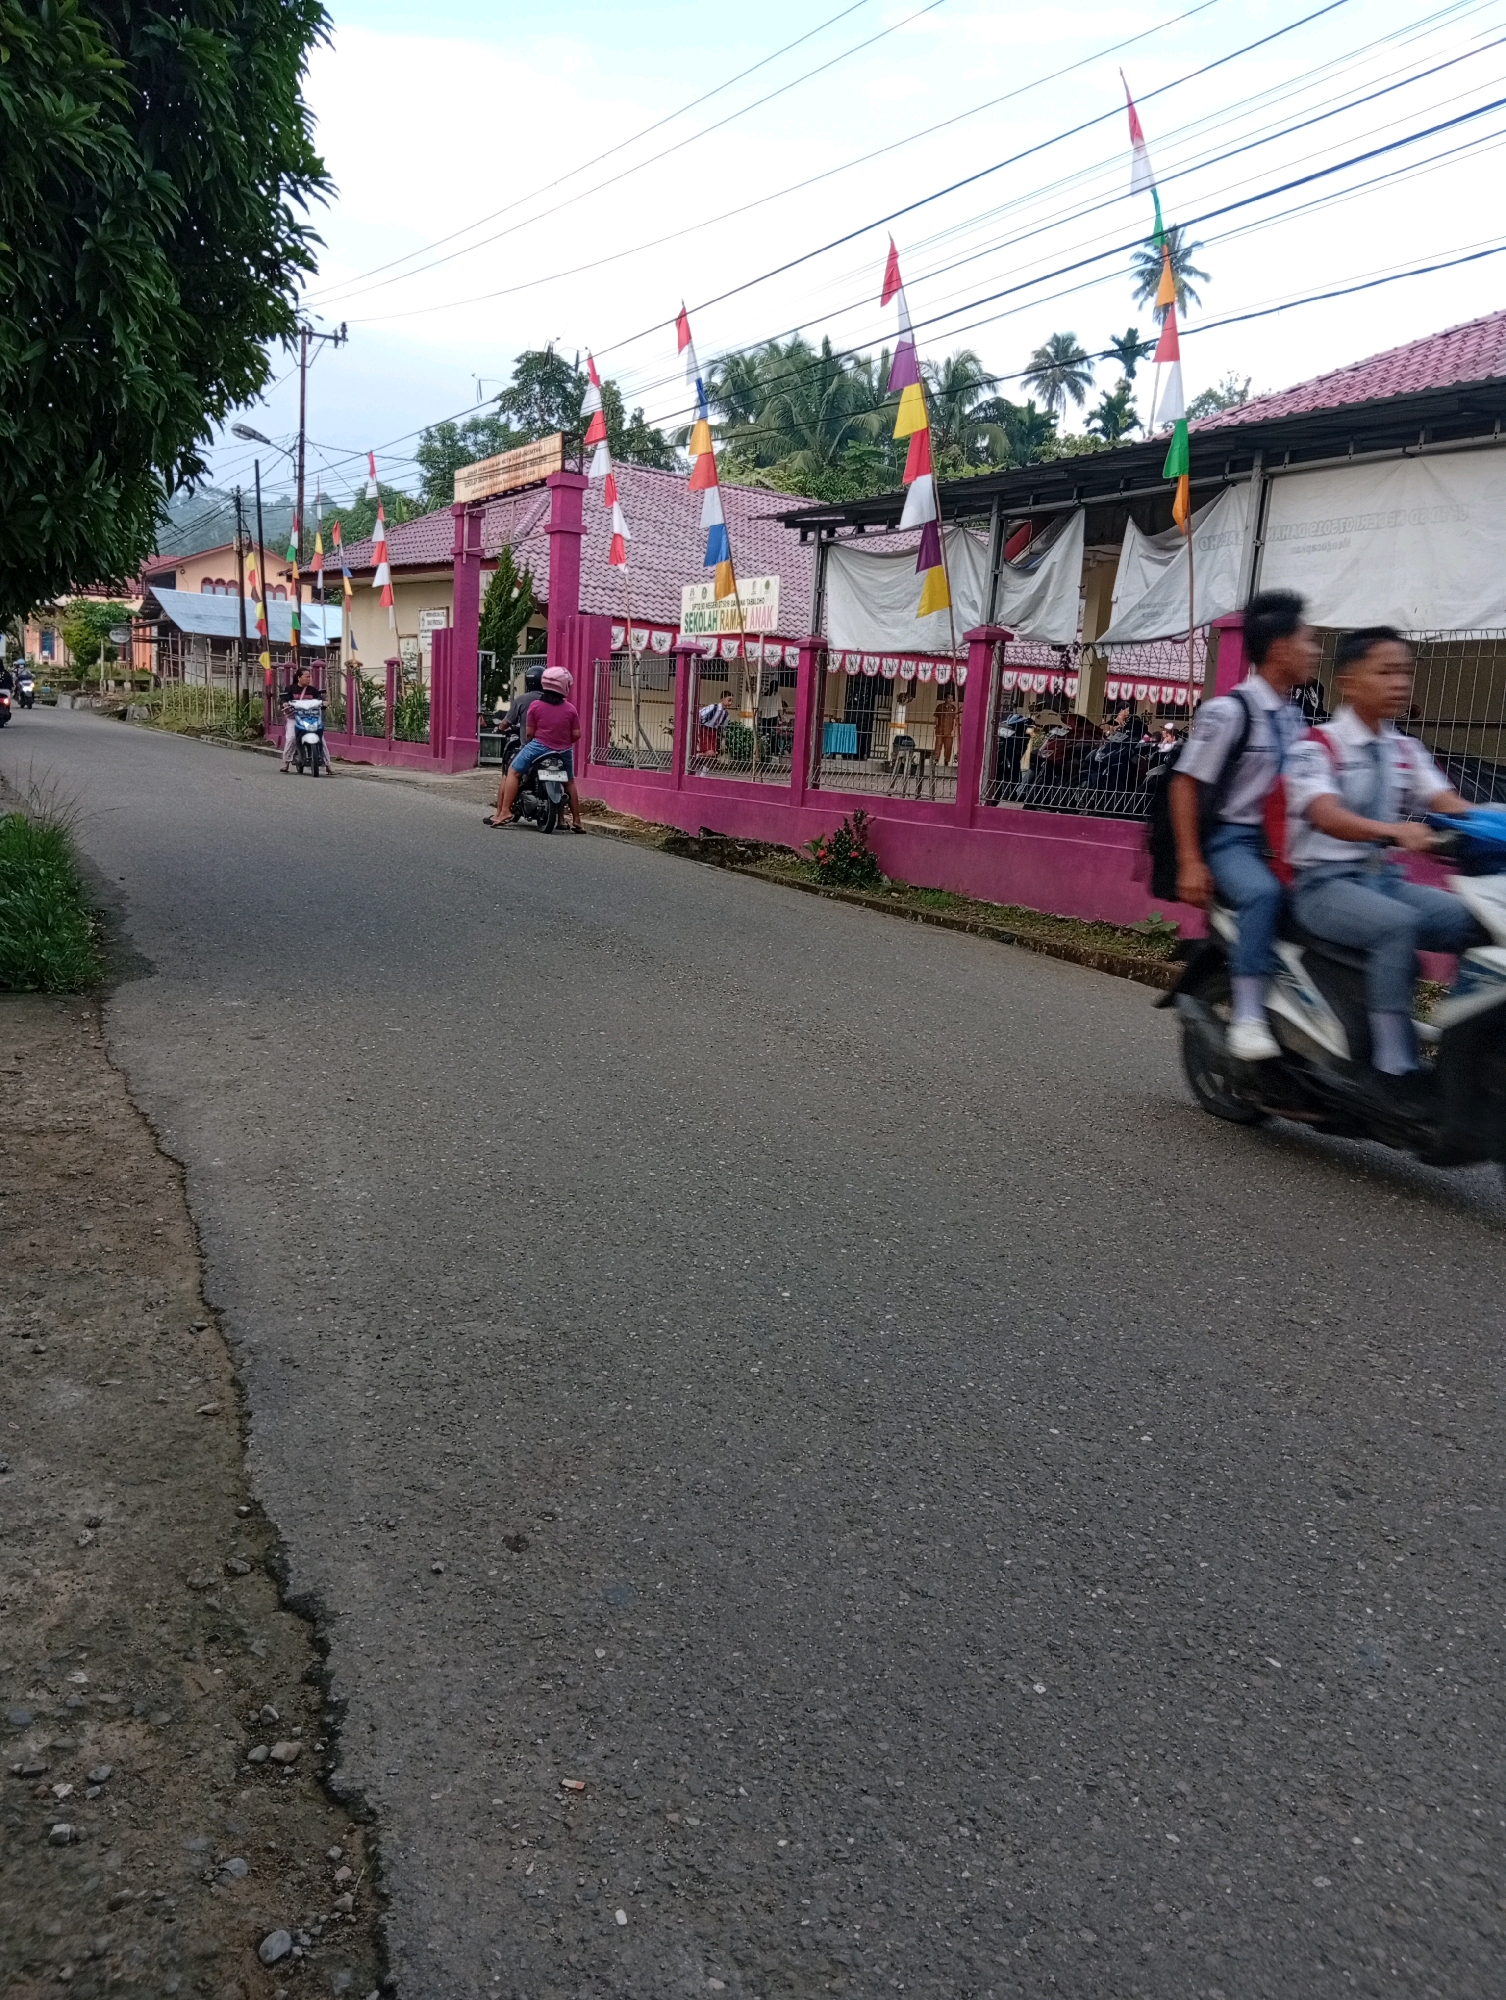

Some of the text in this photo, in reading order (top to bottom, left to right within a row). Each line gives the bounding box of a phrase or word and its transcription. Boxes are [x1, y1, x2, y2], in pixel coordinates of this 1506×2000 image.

[684, 605, 774, 633] SEKOLAH RAMAH ANAK
